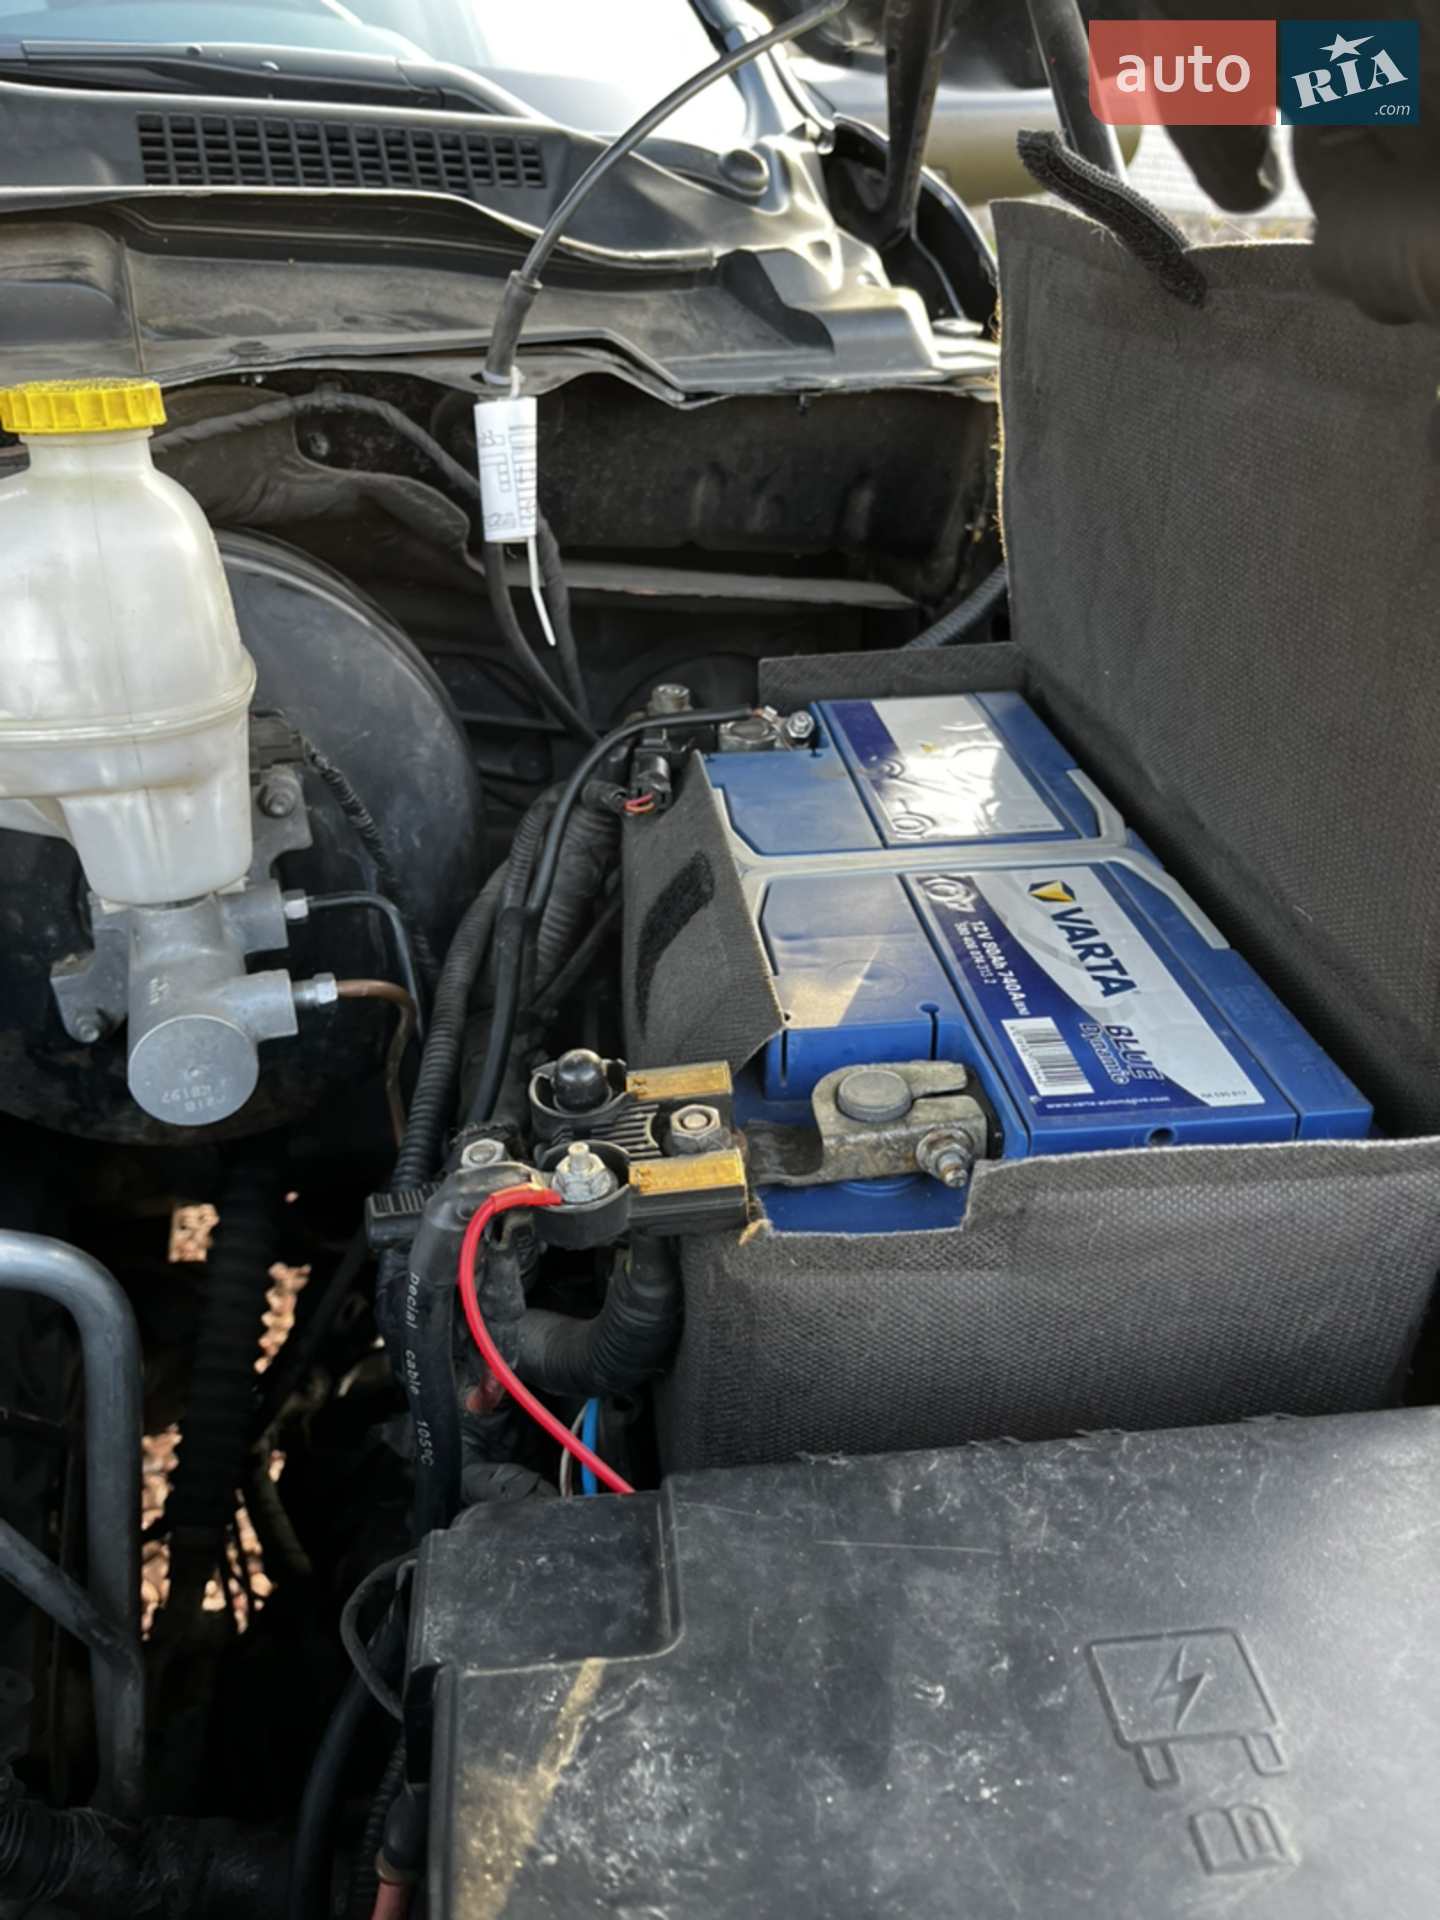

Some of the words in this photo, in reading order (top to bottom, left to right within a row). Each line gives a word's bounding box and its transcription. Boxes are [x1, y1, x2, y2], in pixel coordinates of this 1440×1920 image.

[1050, 906, 1138, 998] VARTA
[1079, 1022, 1130, 1085] Dynamic
[1104, 1024, 1165, 1081] BLUE
[405, 1271, 421, 1329] pecial
[404, 1349, 422, 1395] cable
